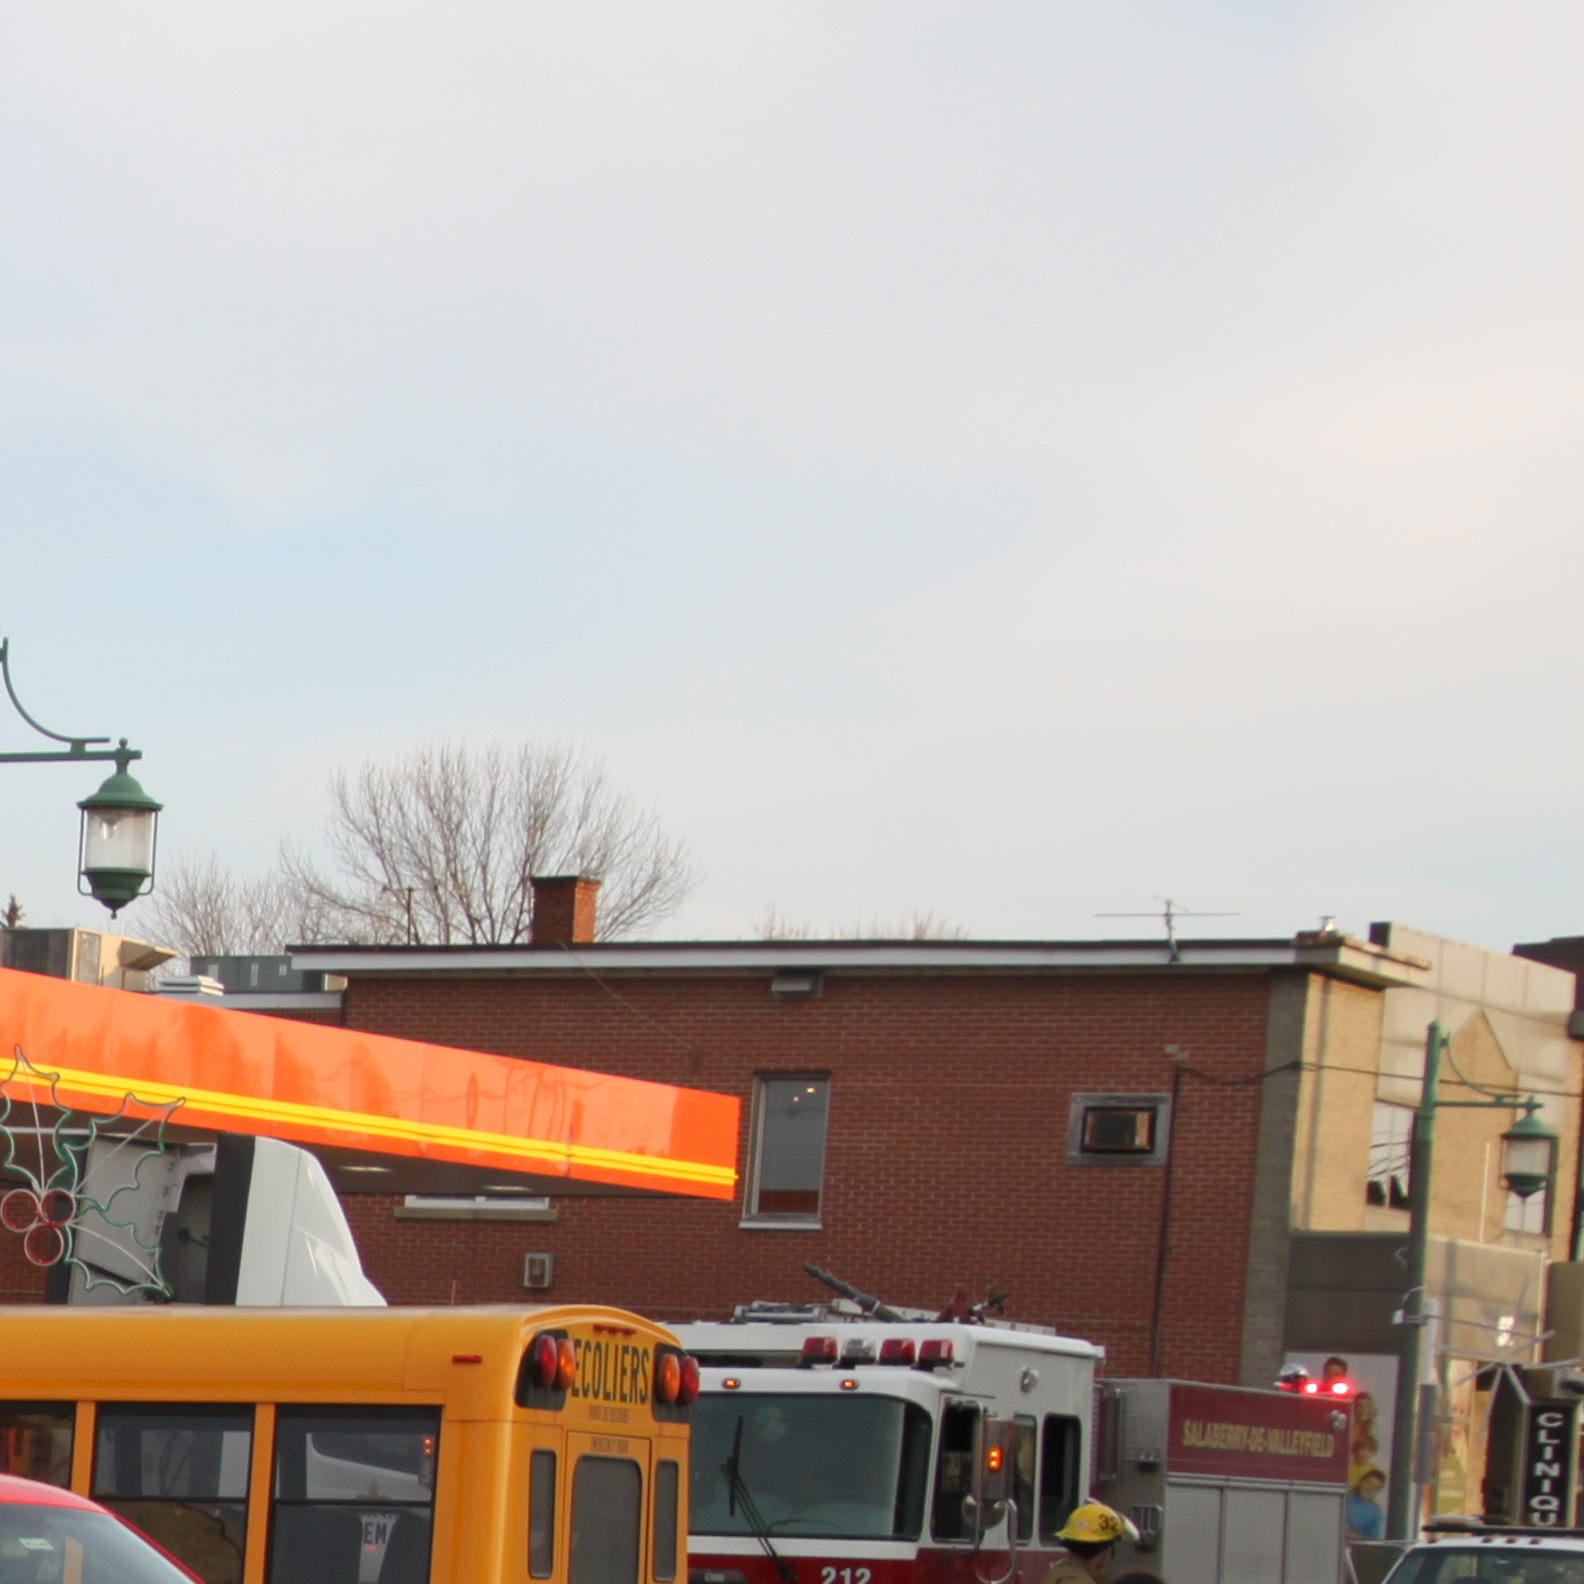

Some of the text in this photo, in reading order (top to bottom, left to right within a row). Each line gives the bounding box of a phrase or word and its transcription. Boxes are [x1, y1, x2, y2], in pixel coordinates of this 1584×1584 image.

[571, 1339, 651, 1405] ECOLIERS
[1183, 1418, 1335, 1459] SALABERRY-DE-VALLEYFIELD
[1529, 1412, 1564, 1526] CLINIQU
[1098, 1513, 1119, 1532] 32
